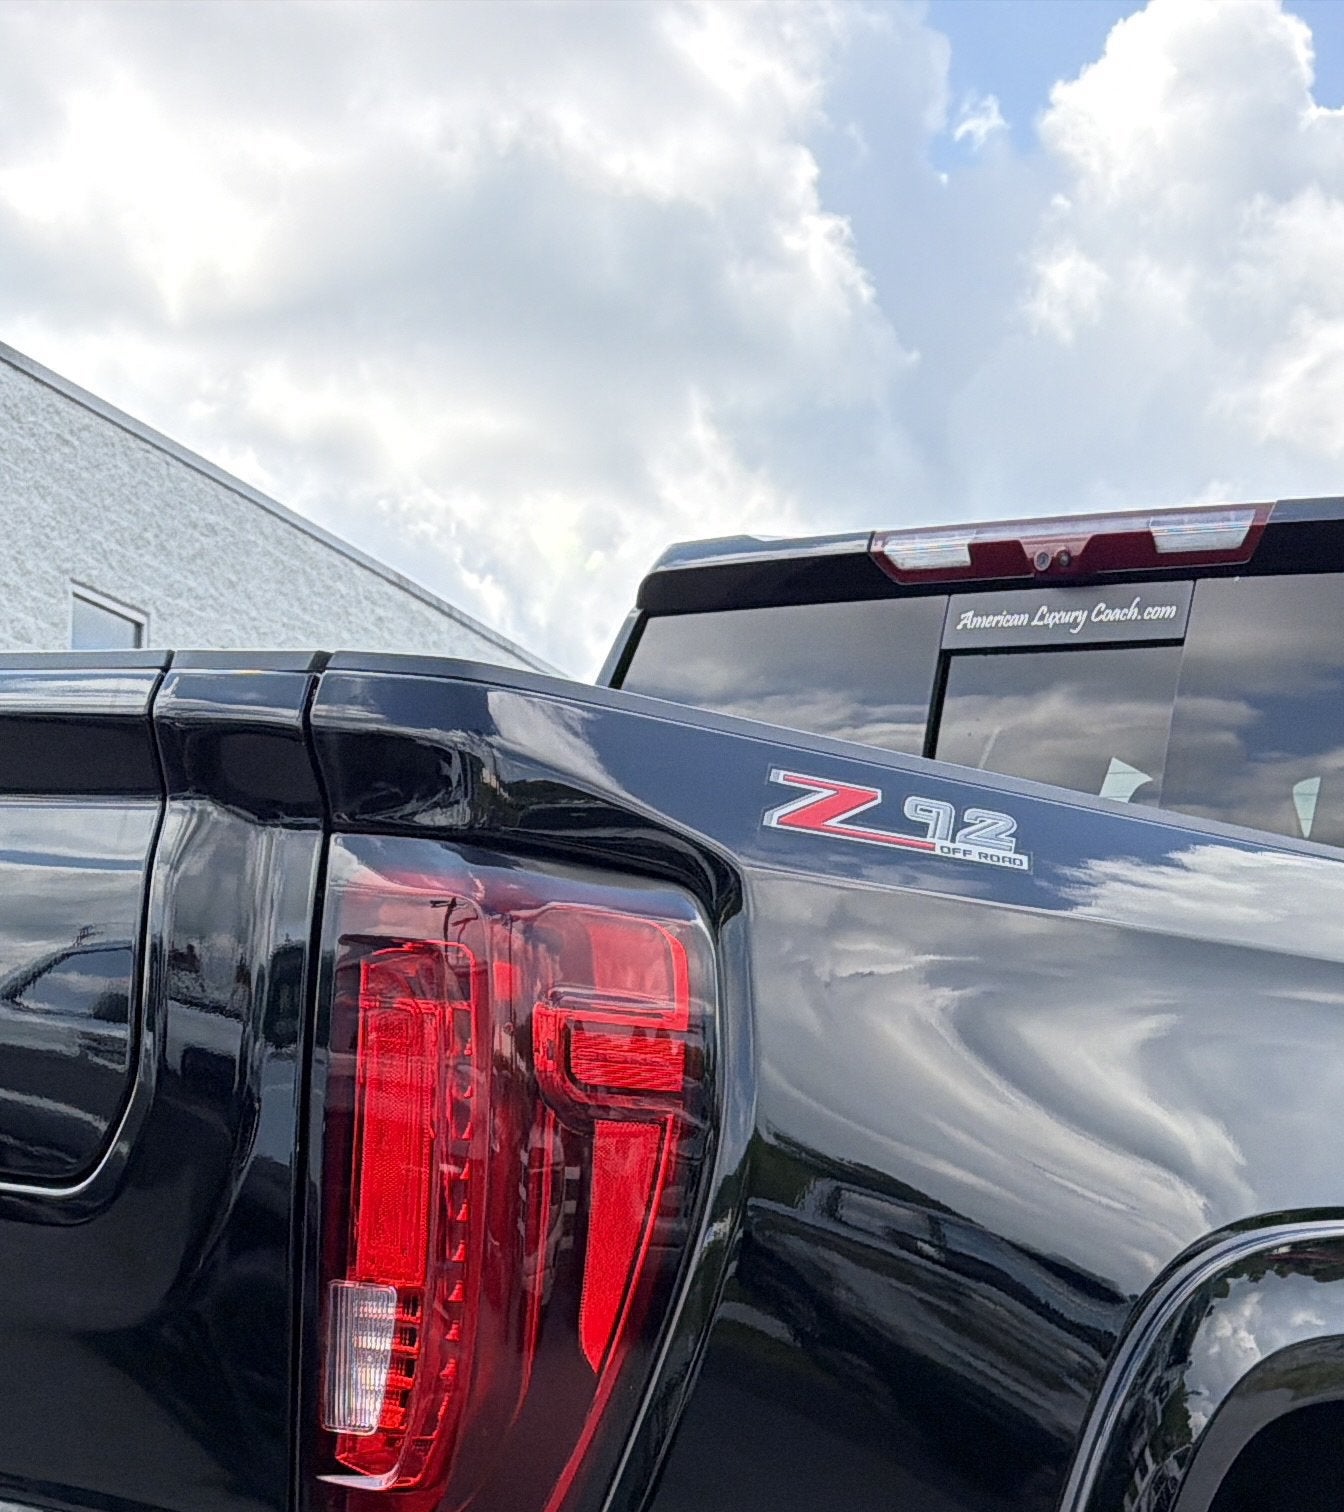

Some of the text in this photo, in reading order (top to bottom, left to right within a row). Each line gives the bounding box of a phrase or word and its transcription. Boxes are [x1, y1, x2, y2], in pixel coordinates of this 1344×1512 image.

[956, 596, 1177, 634] American Luxury Coach.com
[939, 845, 1024, 867] OFF ROAD
